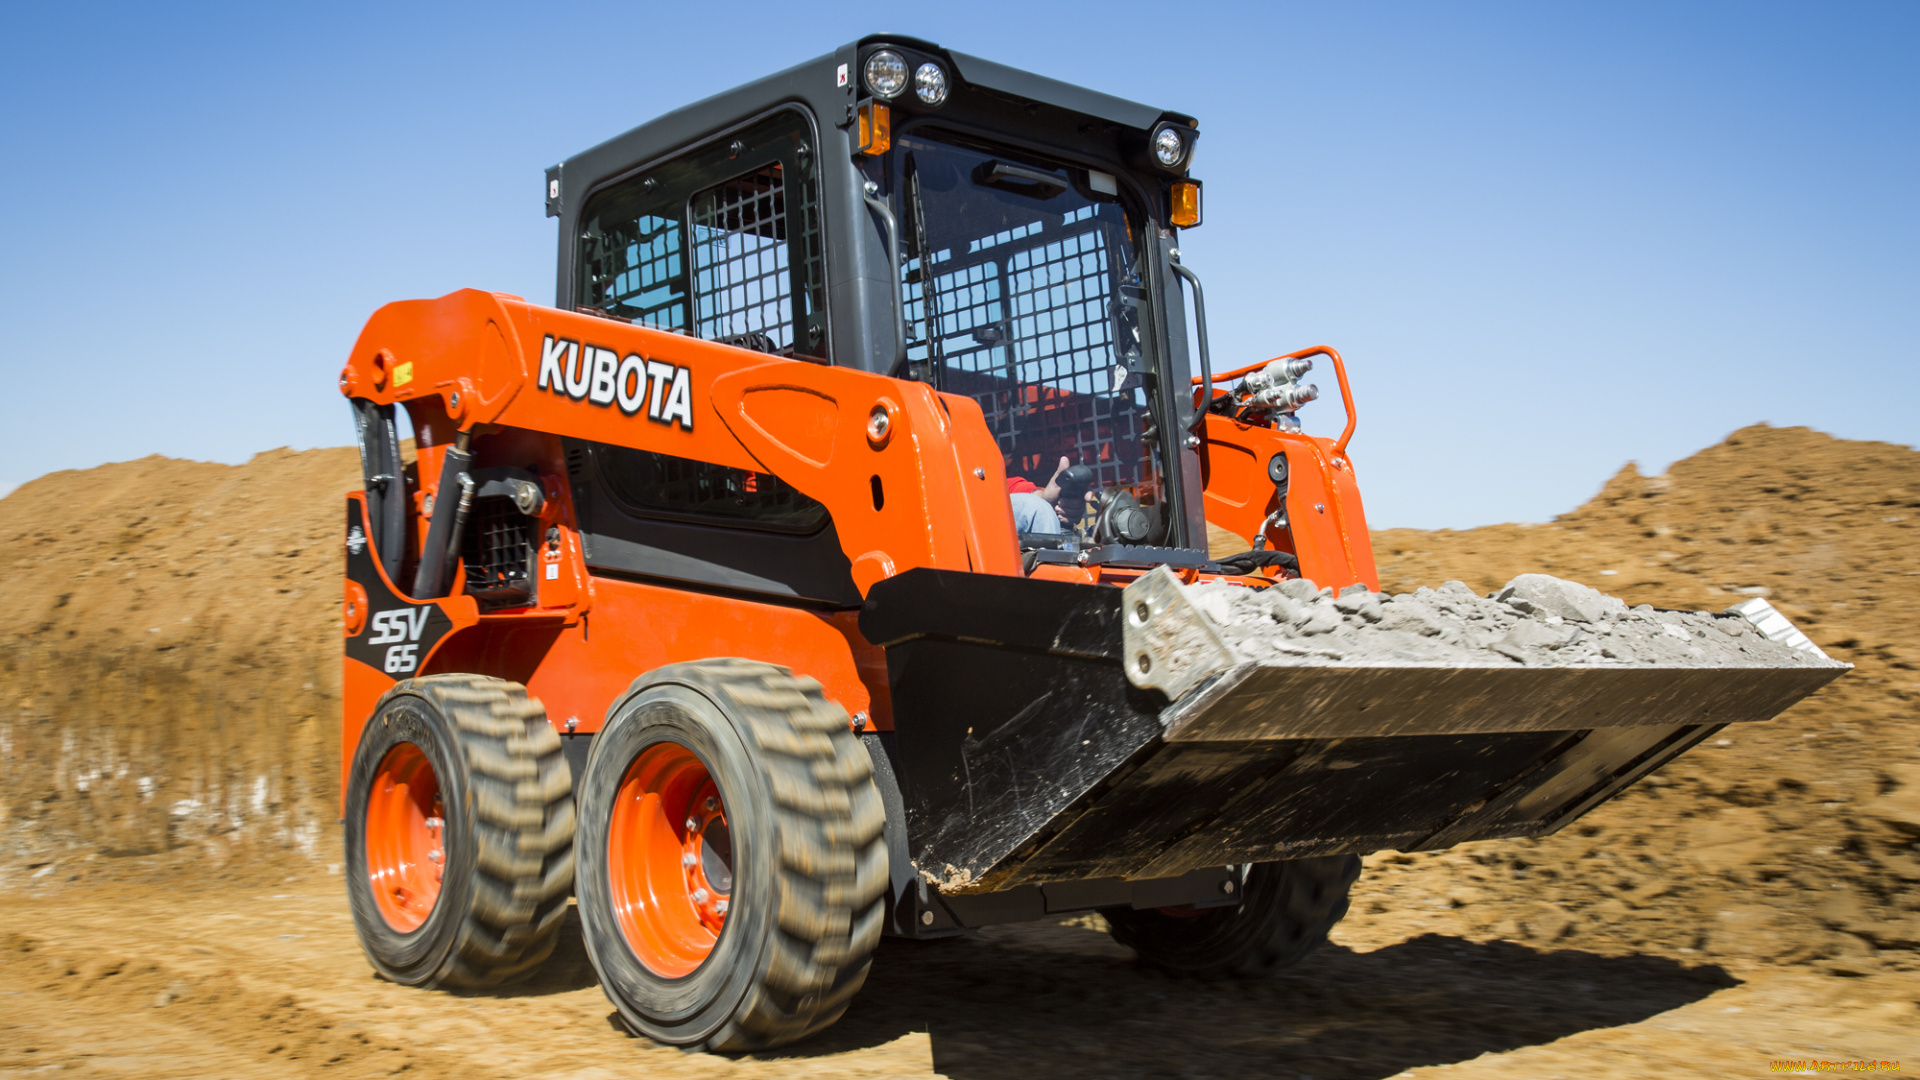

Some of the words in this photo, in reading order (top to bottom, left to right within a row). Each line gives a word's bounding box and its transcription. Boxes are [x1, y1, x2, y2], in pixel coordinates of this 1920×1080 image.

[538, 334, 693, 432] KUBOTA
[368, 605, 431, 645] SSV
[384, 644, 419, 673] 65
